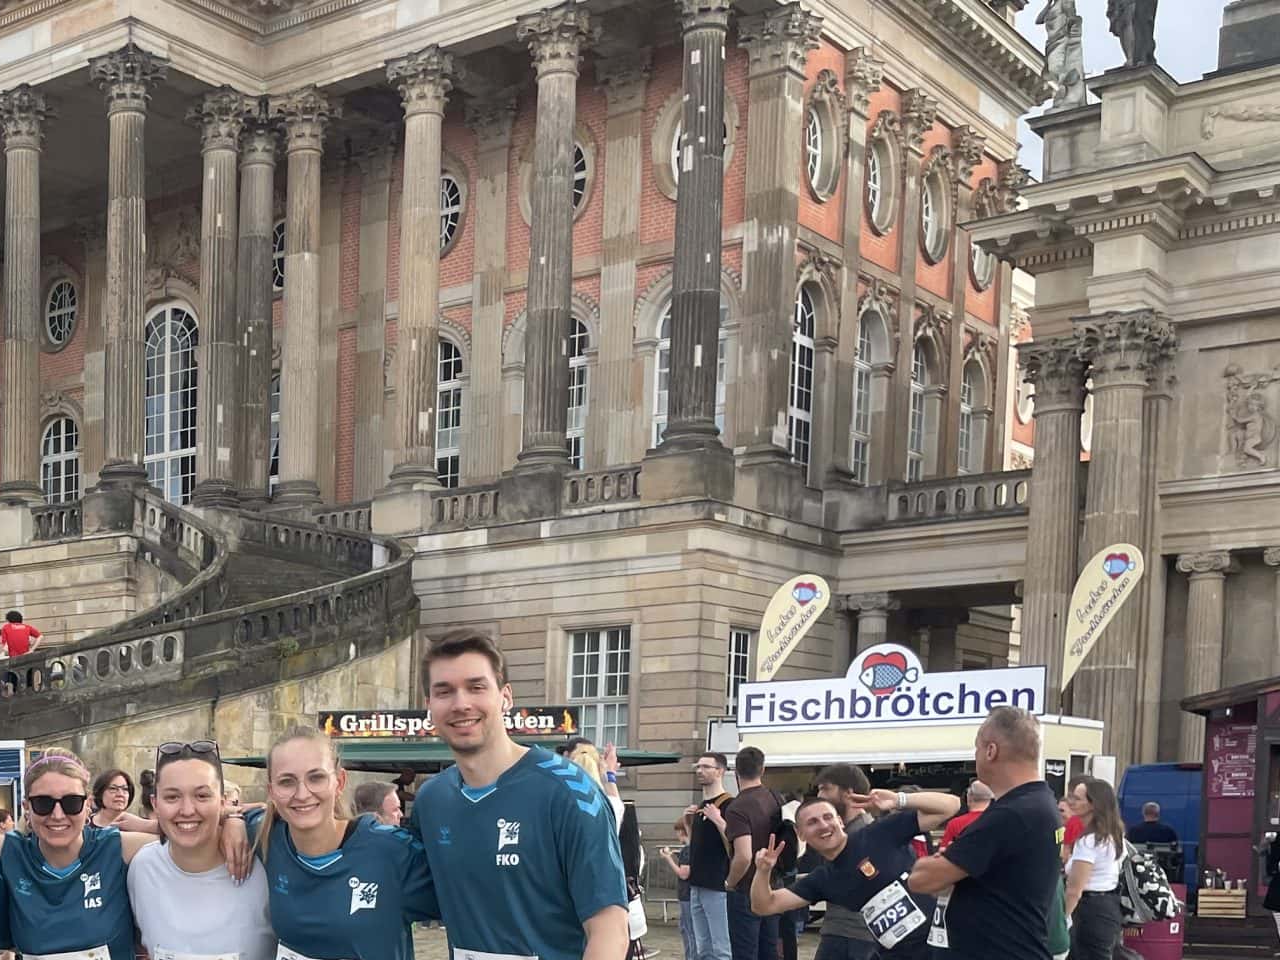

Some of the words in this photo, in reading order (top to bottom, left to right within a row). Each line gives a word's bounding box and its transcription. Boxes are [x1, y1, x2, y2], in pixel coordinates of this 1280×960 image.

[745, 682, 1035, 724] Fischbrötchen
[340, 712, 555, 736] Grillspeäten
[496, 853, 520, 866] FKO
[84, 897, 103, 909] IAS
[872, 902, 908, 934] 7795
